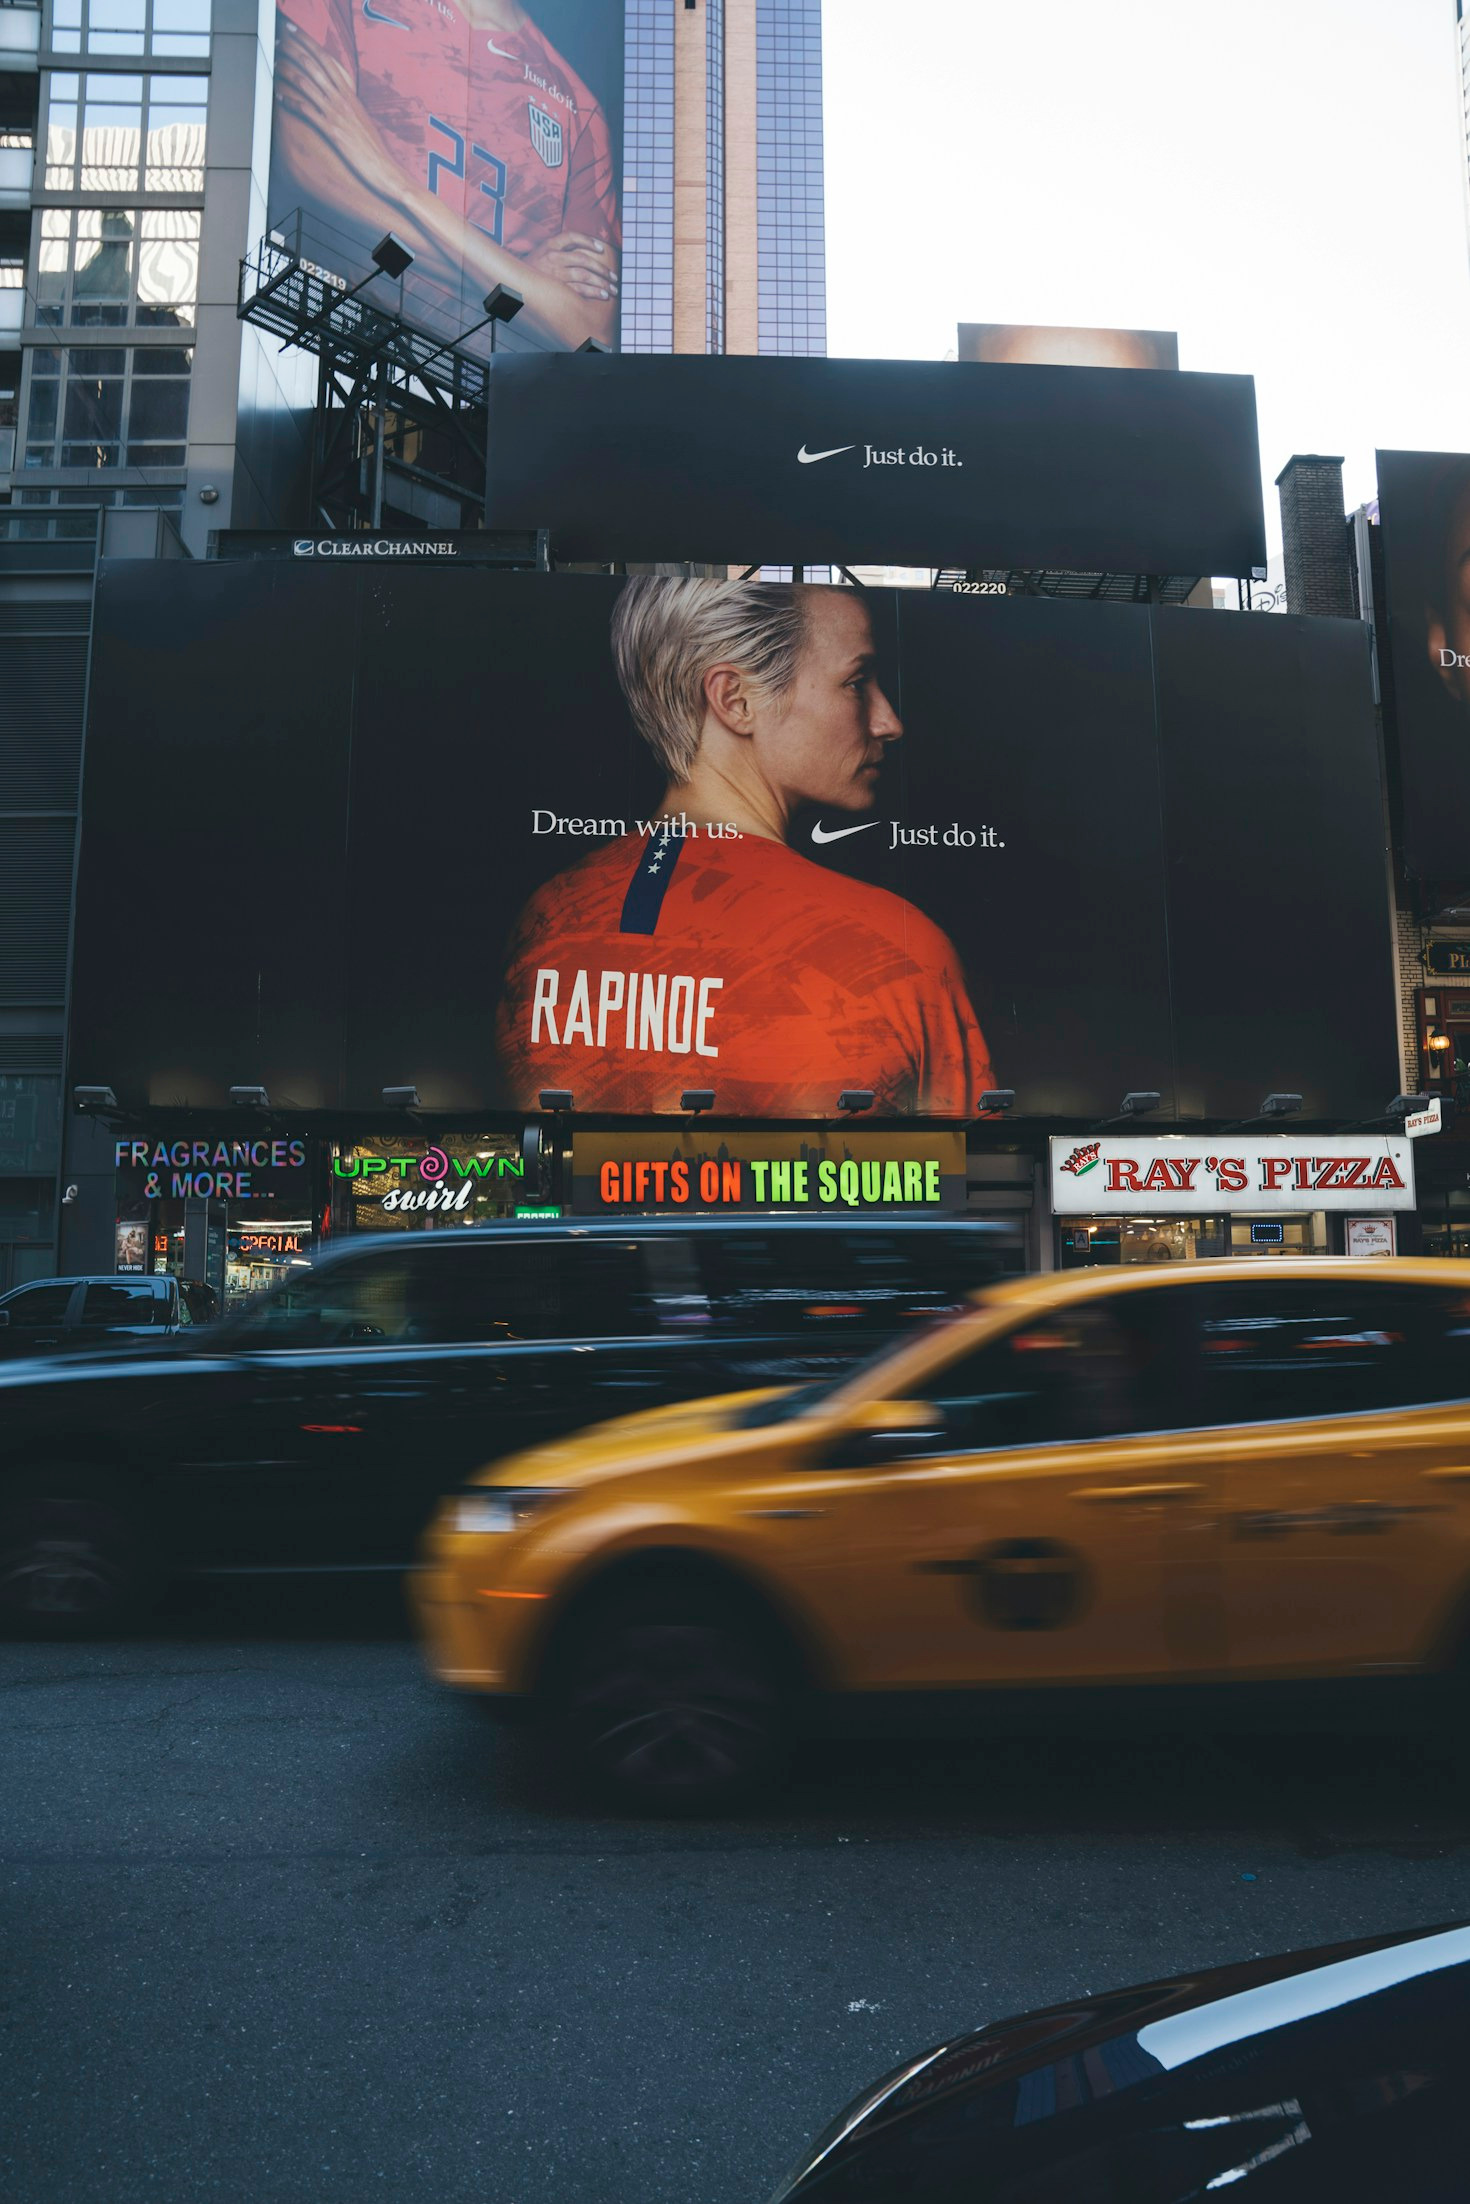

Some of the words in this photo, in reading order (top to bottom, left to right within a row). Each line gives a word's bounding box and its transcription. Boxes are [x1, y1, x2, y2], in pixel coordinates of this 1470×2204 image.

[524, 64, 547, 92] Just
[548, 85, 564, 103] do
[566, 96, 577, 114] it.
[531, 108, 560, 139] USA
[427, 113, 507, 247] 23
[300, 258, 347, 291] 022219
[863, 445, 905, 468] Just
[909, 446, 937, 466] do
[941, 448, 963, 467] it.
[953, 582, 1007, 595] 022220
[532, 810, 628, 836] Dream
[635, 812, 698, 838] with
[706, 821, 744, 839] us.
[889, 821, 939, 849] Just
[943, 823, 975, 847] do
[980, 826, 1006, 848] it.
[531, 968, 724, 1058] RAPINOE
[1407, 1115, 1422, 1128] RAY'S
[1423, 1113, 1439, 1125] PIZZA
[115, 1141, 306, 1167] FRAGRANCES
[335, 1147, 525, 1180] UPTOWN
[1074, 1152, 1097, 1171] RAY'S
[144, 1172, 162, 1198] &
[172, 1172, 275, 1198] MORE...
[601, 1161, 689, 1203] GIFTS
[700, 1161, 742, 1203] ON
[751, 1161, 809, 1202] THE
[818, 1160, 941, 1206] SQUARE
[1104, 1156, 1249, 1193] RAY'S
[1259, 1155, 1407, 1191] PIZZA
[382, 1180, 473, 1211] swirl
